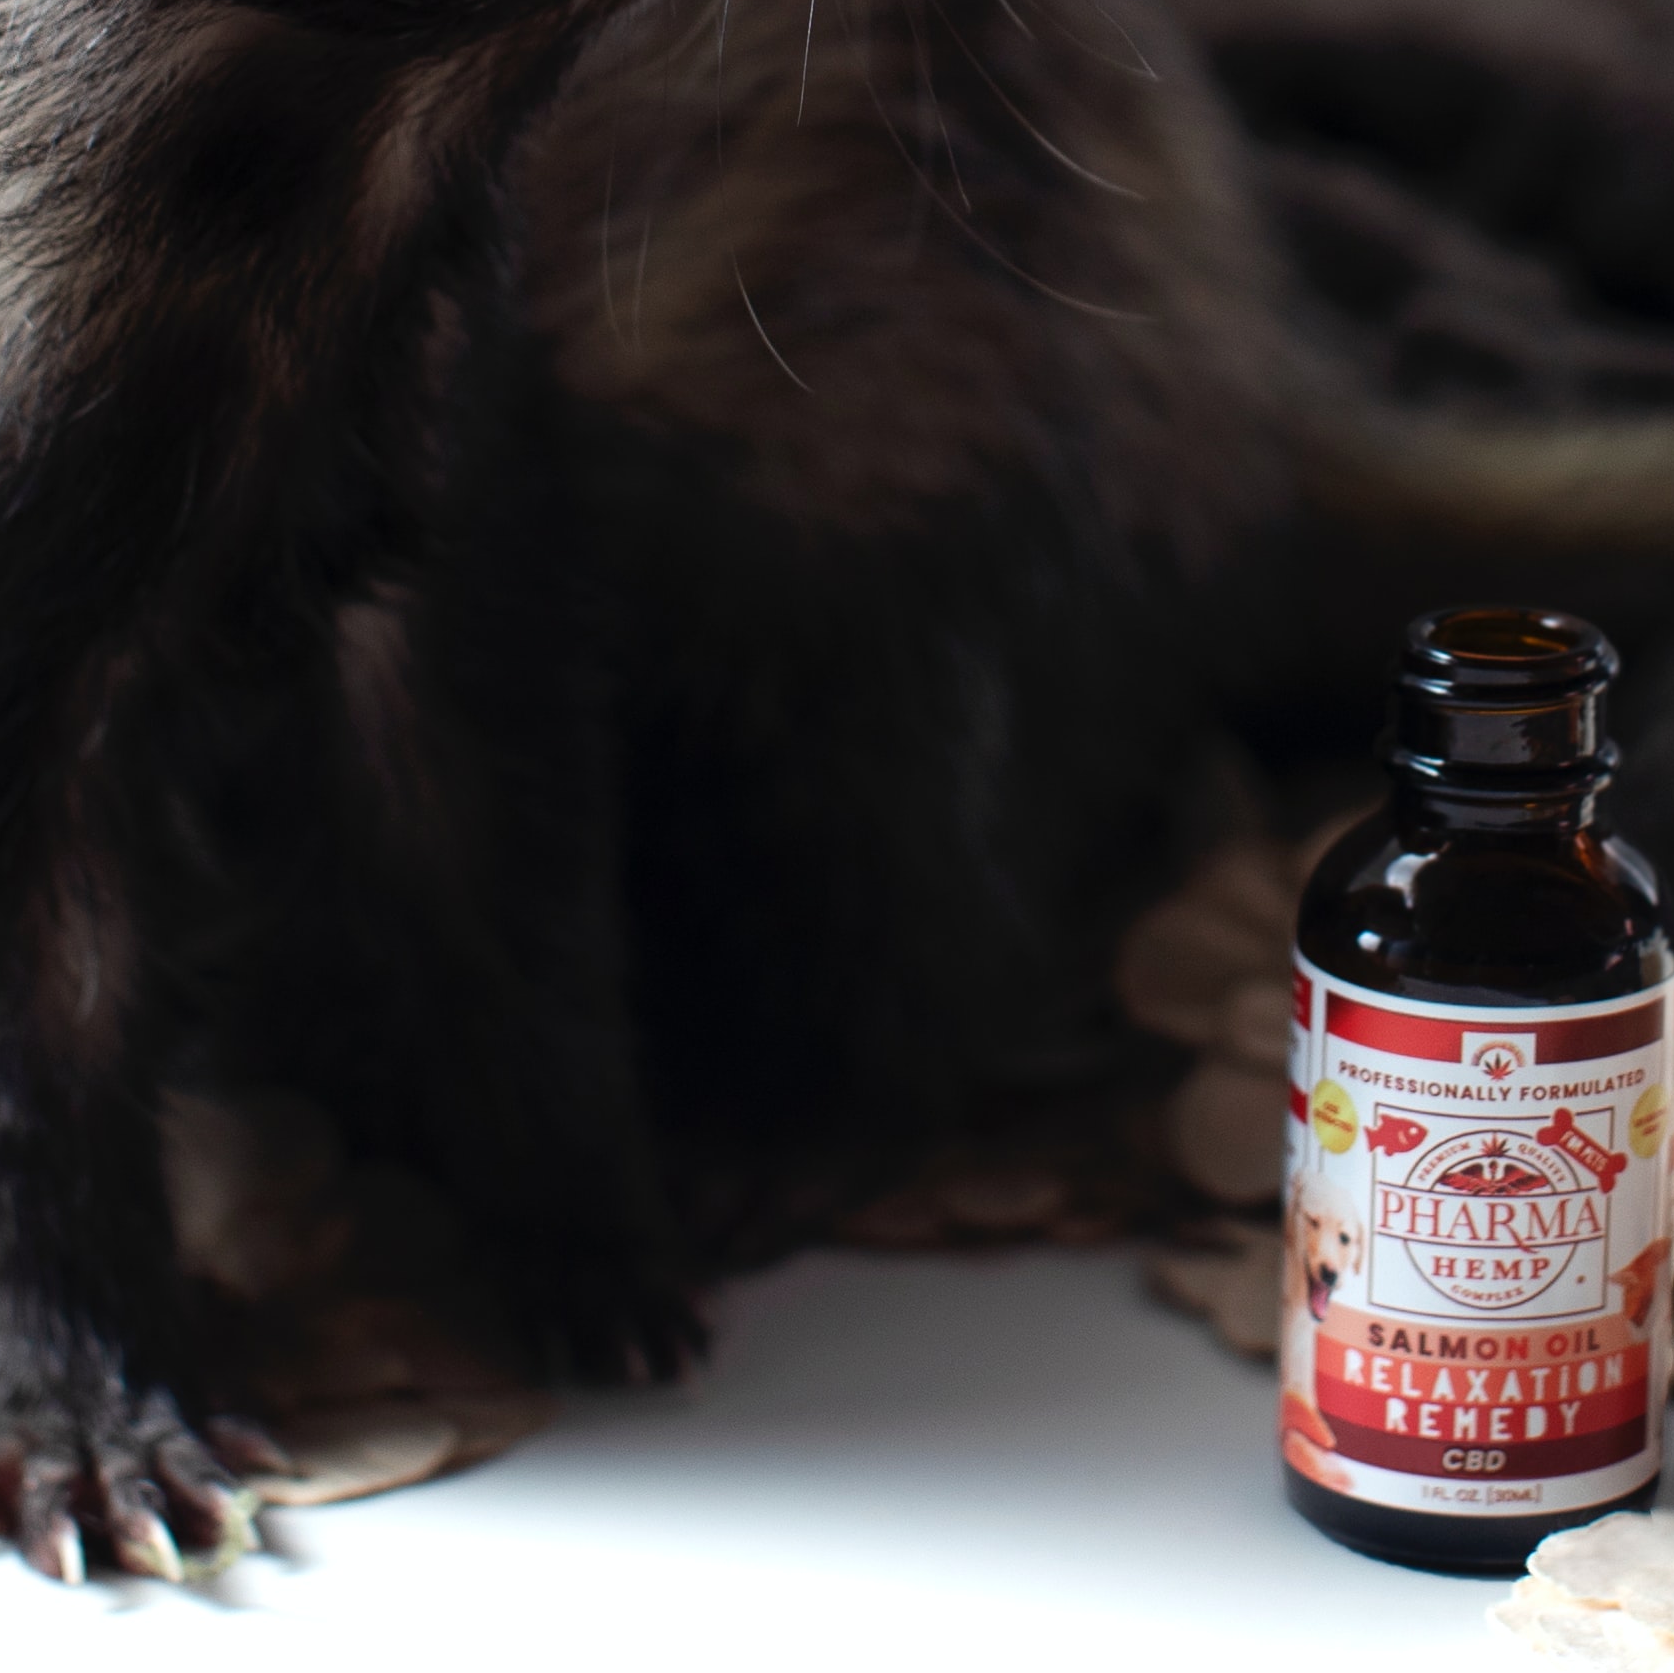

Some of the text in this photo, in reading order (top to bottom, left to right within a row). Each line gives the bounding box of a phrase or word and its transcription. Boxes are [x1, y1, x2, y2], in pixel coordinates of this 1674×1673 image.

[1339, 1060, 1646, 1102] PROFESSIONALLY FORMULATED
[1418, 1141, 1566, 1183] PREMIUM QUALITY
[1379, 1189, 1603, 1254] PHARMA
[1431, 1255, 1551, 1281] HEMP
[1450, 1283, 1524, 1303] COMPLEX
[1368, 1323, 1601, 1361] SALMON OIL
[1384, 1397, 1582, 1441] REMEDY
[1441, 1446, 1508, 1473] CBD
